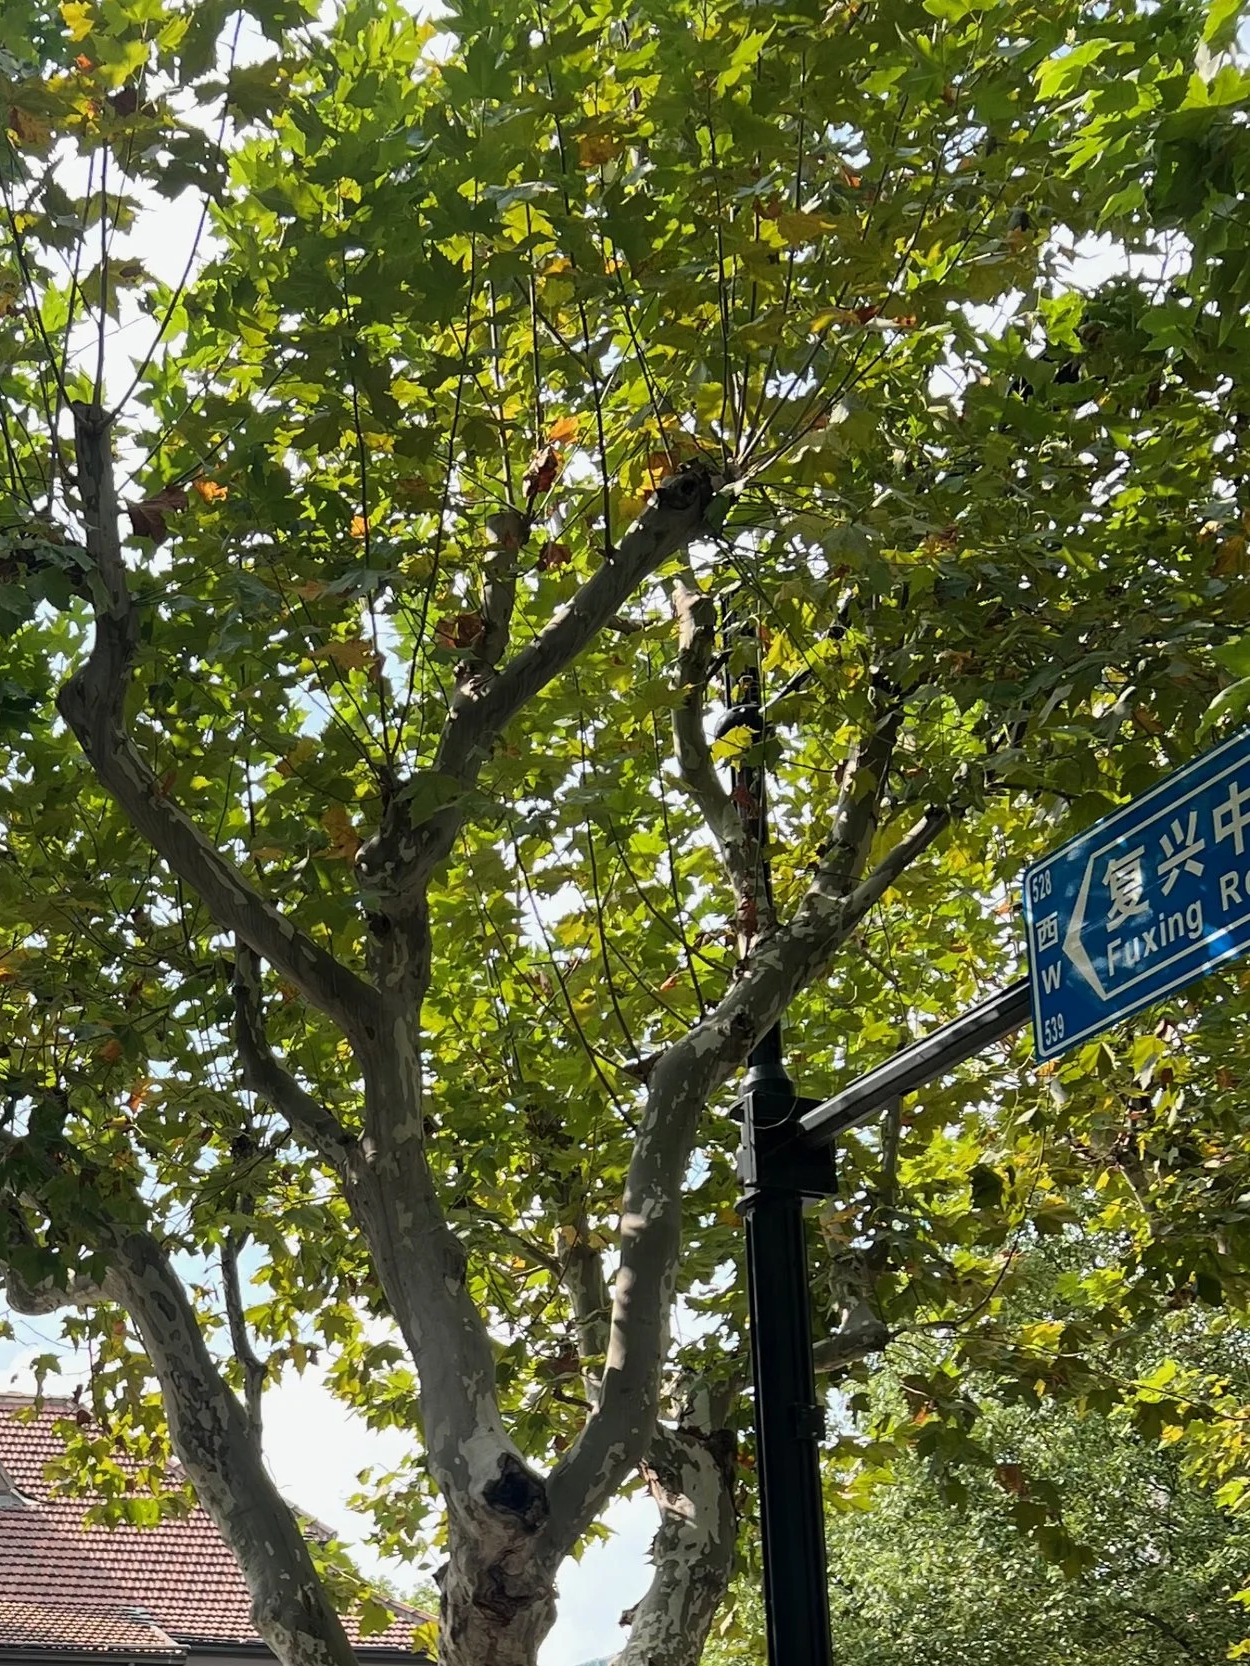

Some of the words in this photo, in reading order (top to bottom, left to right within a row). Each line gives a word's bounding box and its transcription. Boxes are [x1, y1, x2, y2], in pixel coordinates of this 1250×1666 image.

[1102, 780, 1250, 933] 复兴中
[1032, 869, 1052, 904] 528
[1035, 910, 1059, 952] 西
[1106, 898, 1204, 977] Fuxing
[1218, 869, 1250, 912] R
[1041, 960, 1062, 994] W
[1044, 1012, 1065, 1047] 539
